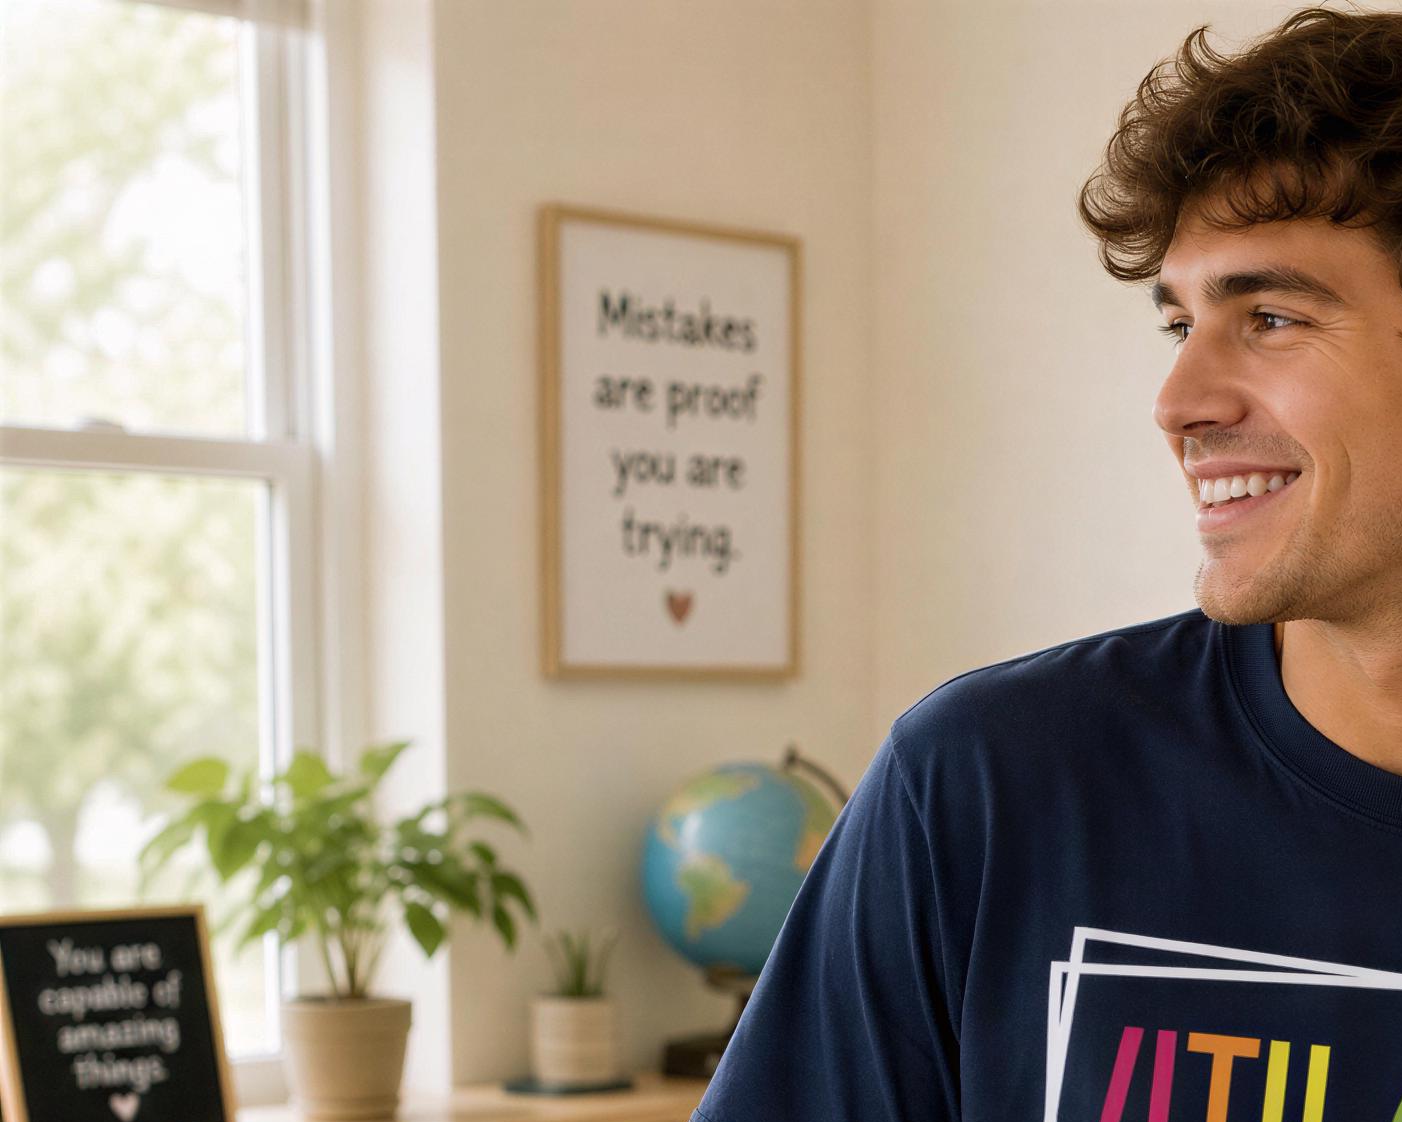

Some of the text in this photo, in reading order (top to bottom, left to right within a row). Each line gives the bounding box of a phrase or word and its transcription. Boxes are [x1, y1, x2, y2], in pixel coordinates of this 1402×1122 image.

[598, 289, 758, 351] Mistakes
[594, 373, 762, 427] are proof
[612, 448, 745, 497] you are
[47, 937, 162, 977] You are
[38, 969, 182, 1020] capable of
[57, 1013, 181, 1053] amazing
